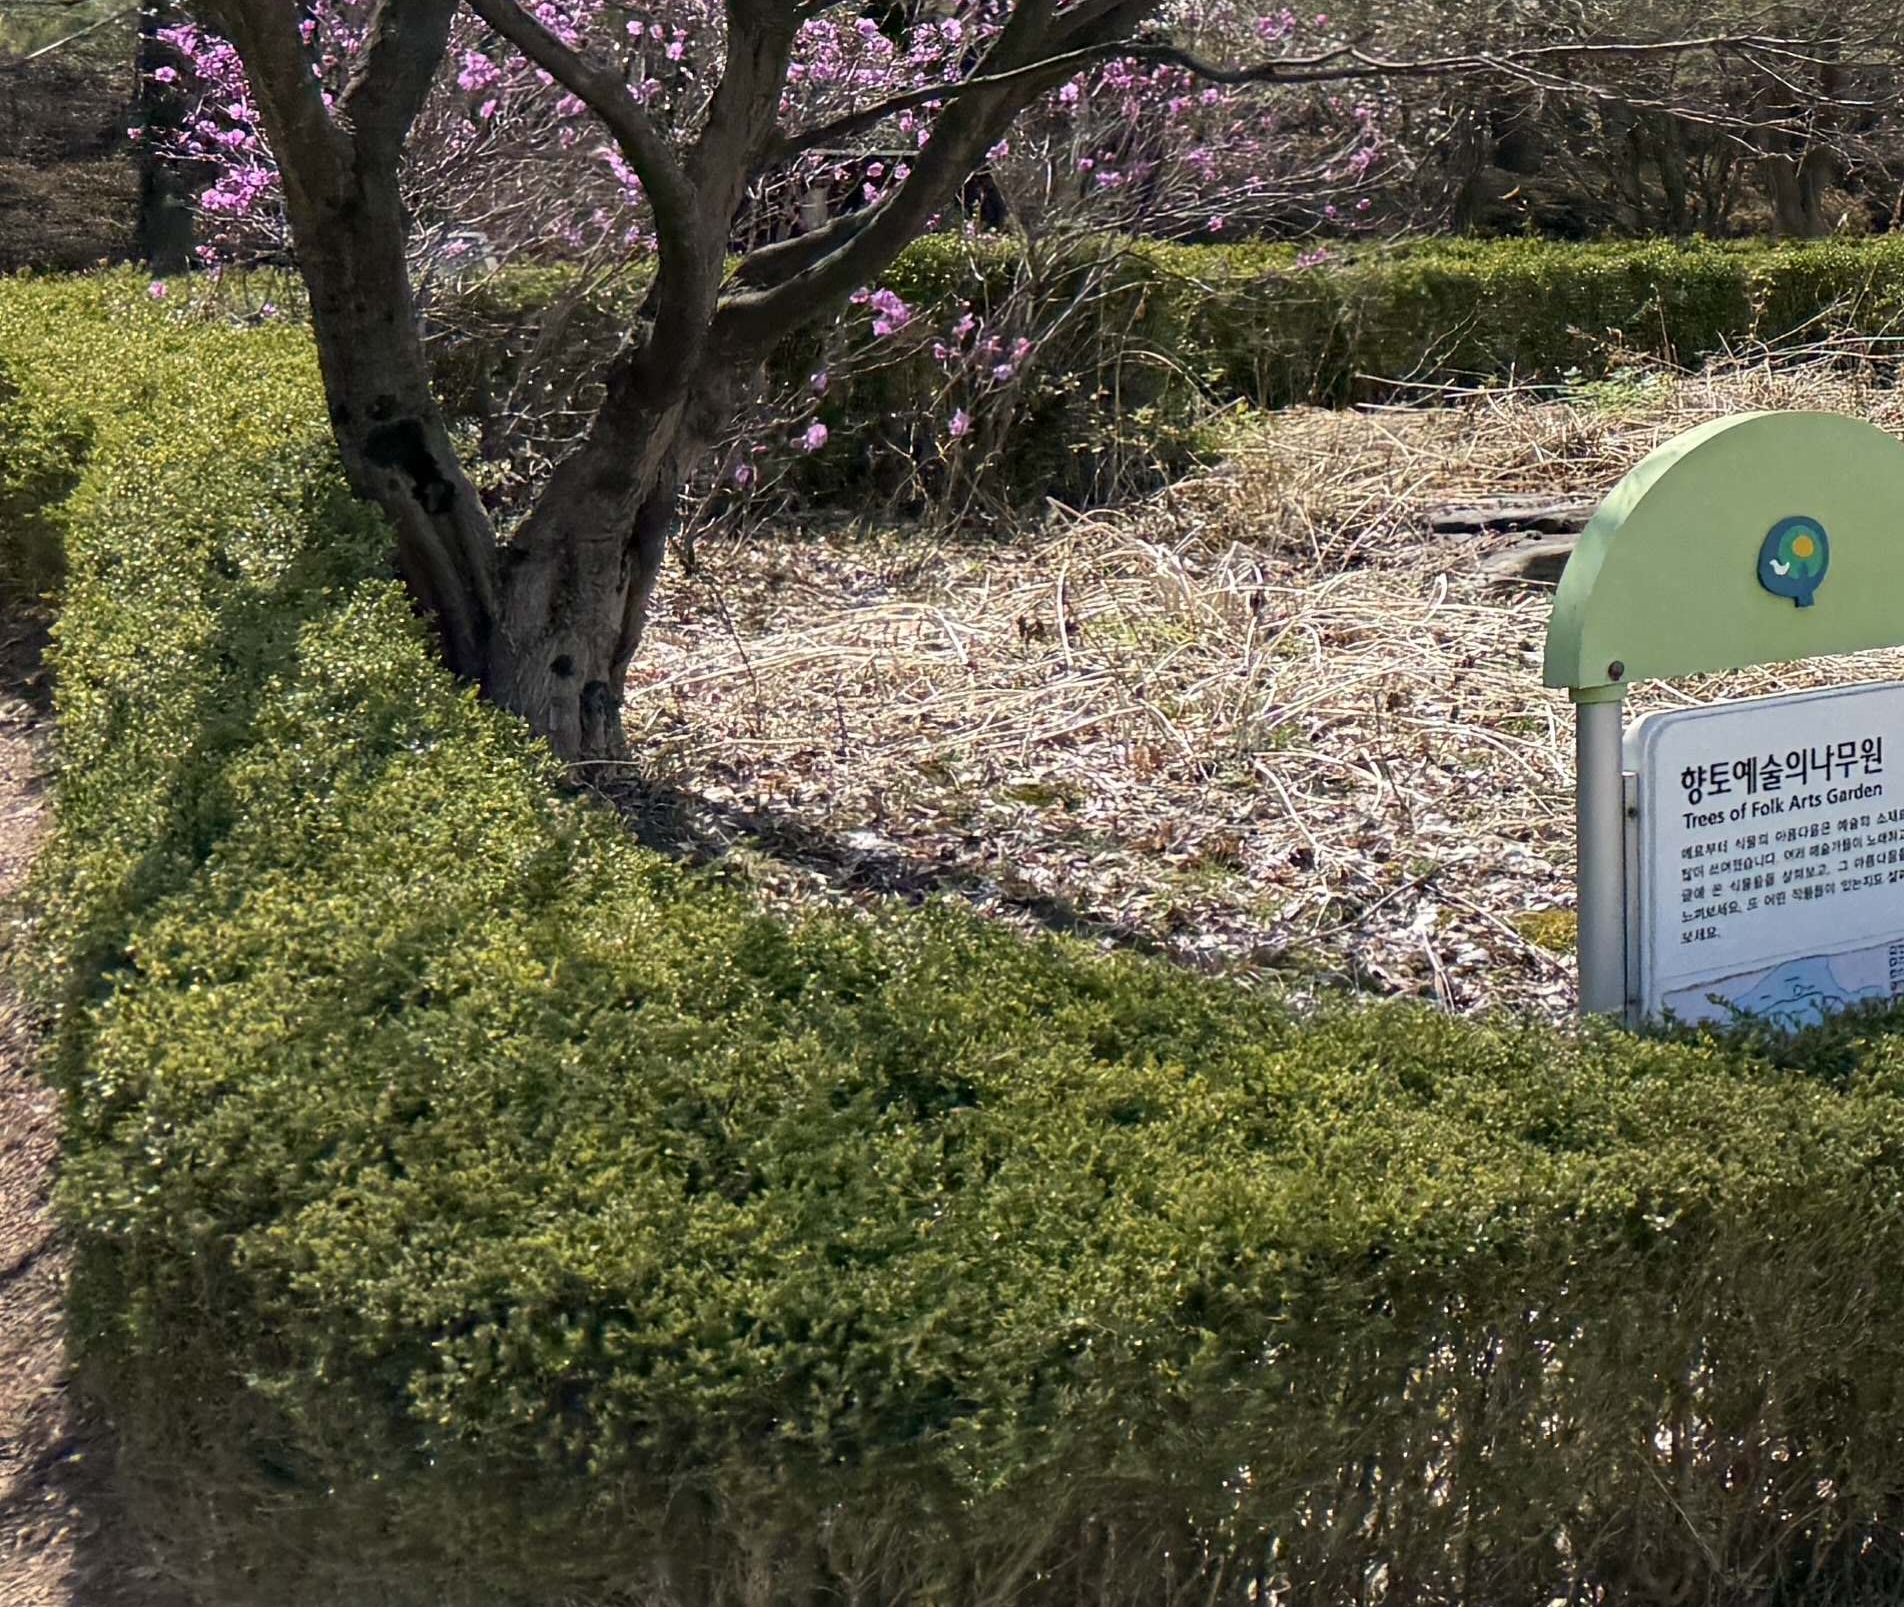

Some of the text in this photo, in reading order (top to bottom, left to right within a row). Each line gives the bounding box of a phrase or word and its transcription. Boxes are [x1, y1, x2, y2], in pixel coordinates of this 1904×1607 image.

[1680, 736, 1884, 806] 향토예술의나무원
[1683, 783, 1883, 829] Trees of Folk Arts Garden
[1838, 860, 1848, 872] 그
